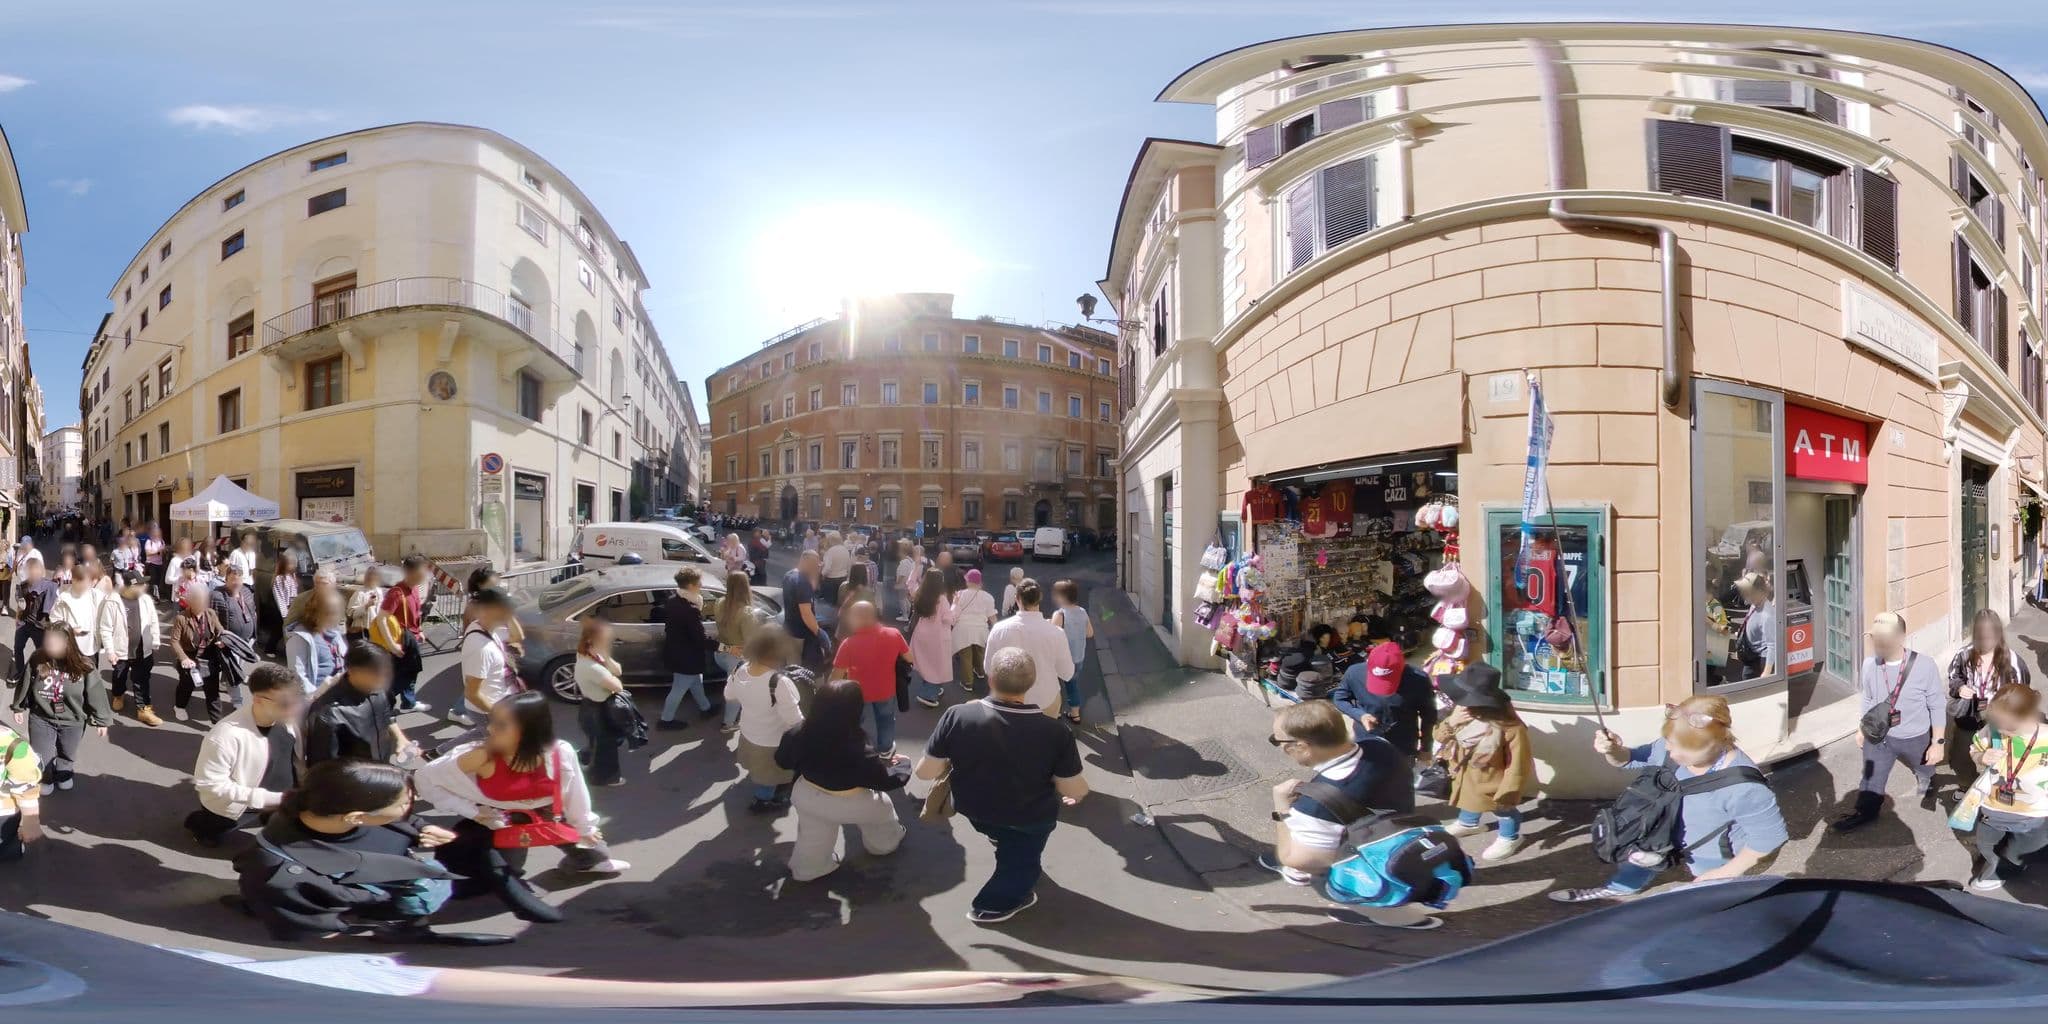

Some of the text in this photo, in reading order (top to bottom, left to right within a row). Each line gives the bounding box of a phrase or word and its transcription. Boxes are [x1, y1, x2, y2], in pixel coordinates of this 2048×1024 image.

[1793, 429, 1860, 463] ATM
[1389, 474, 1402, 488] STI
[1332, 491, 1346, 512] 10
[1384, 487, 1407, 502] CAZZI
[1308, 508, 1320, 523] 21
[1564, 565, 1578, 593] 7
